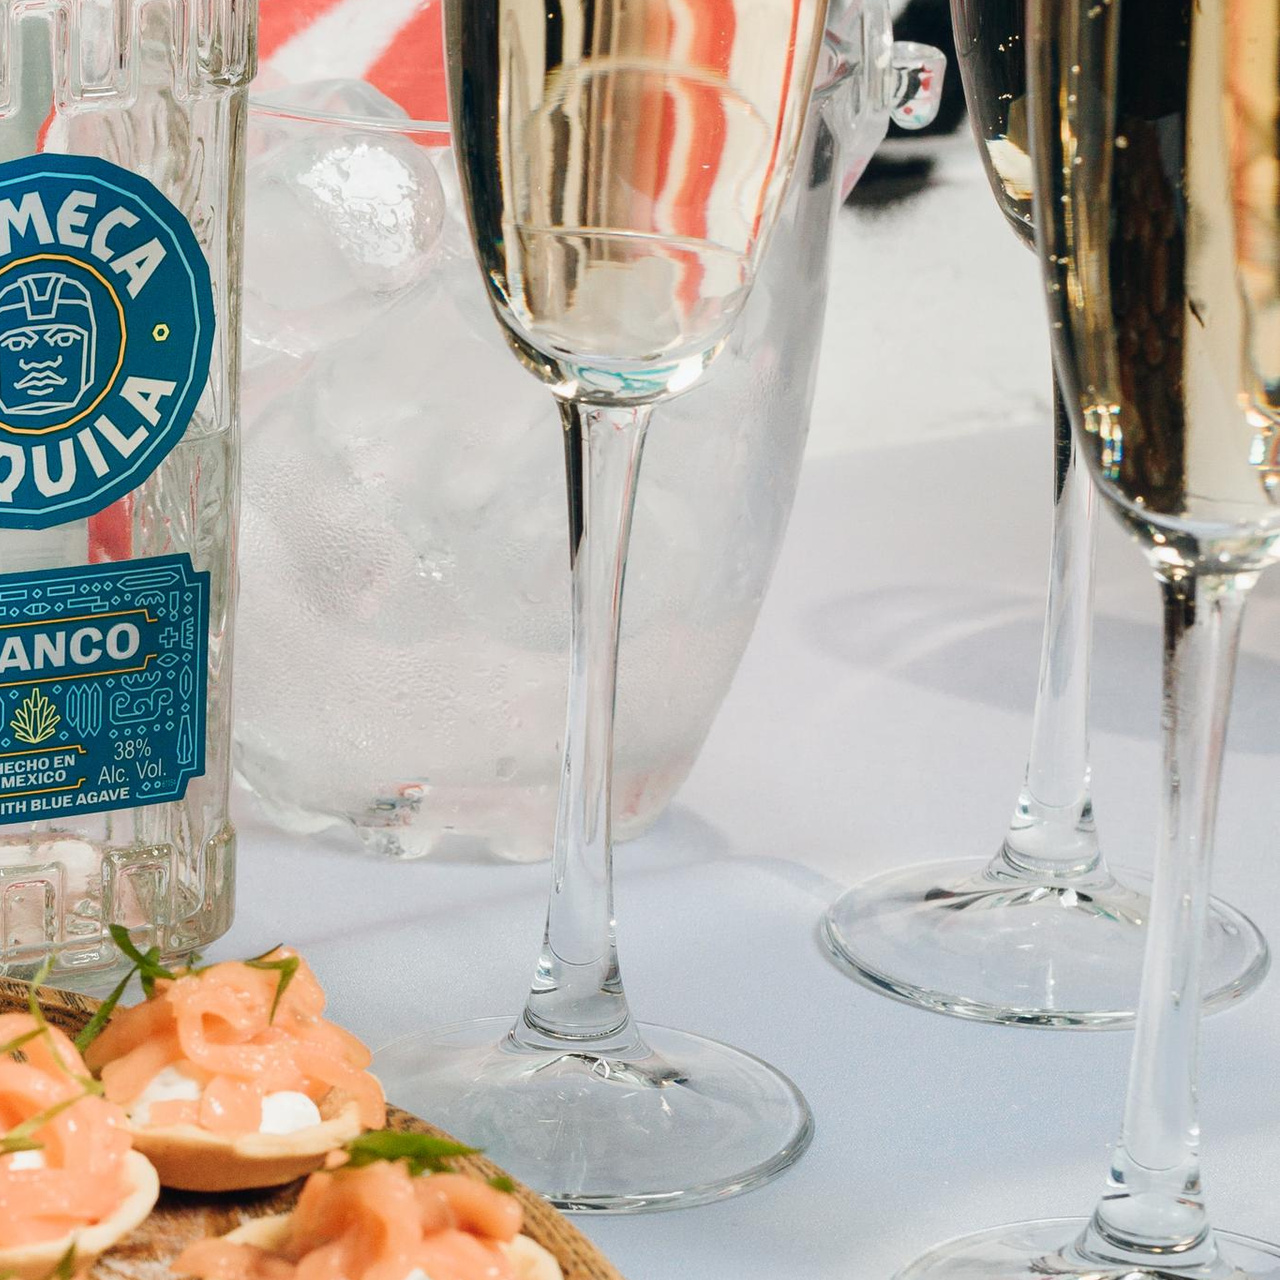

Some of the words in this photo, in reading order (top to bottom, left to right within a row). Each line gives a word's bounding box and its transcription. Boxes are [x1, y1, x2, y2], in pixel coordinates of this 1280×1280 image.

[114, 737, 152, 761] 38%
[53, 754, 76, 770] EN
[98, 764, 130, 786] Alc.
[136, 757, 167, 780] Vol.
[1, 770, 67, 789] MEXICO
[30, 795, 72, 812] BLUE
[75, 787, 130, 807] AGAVE
